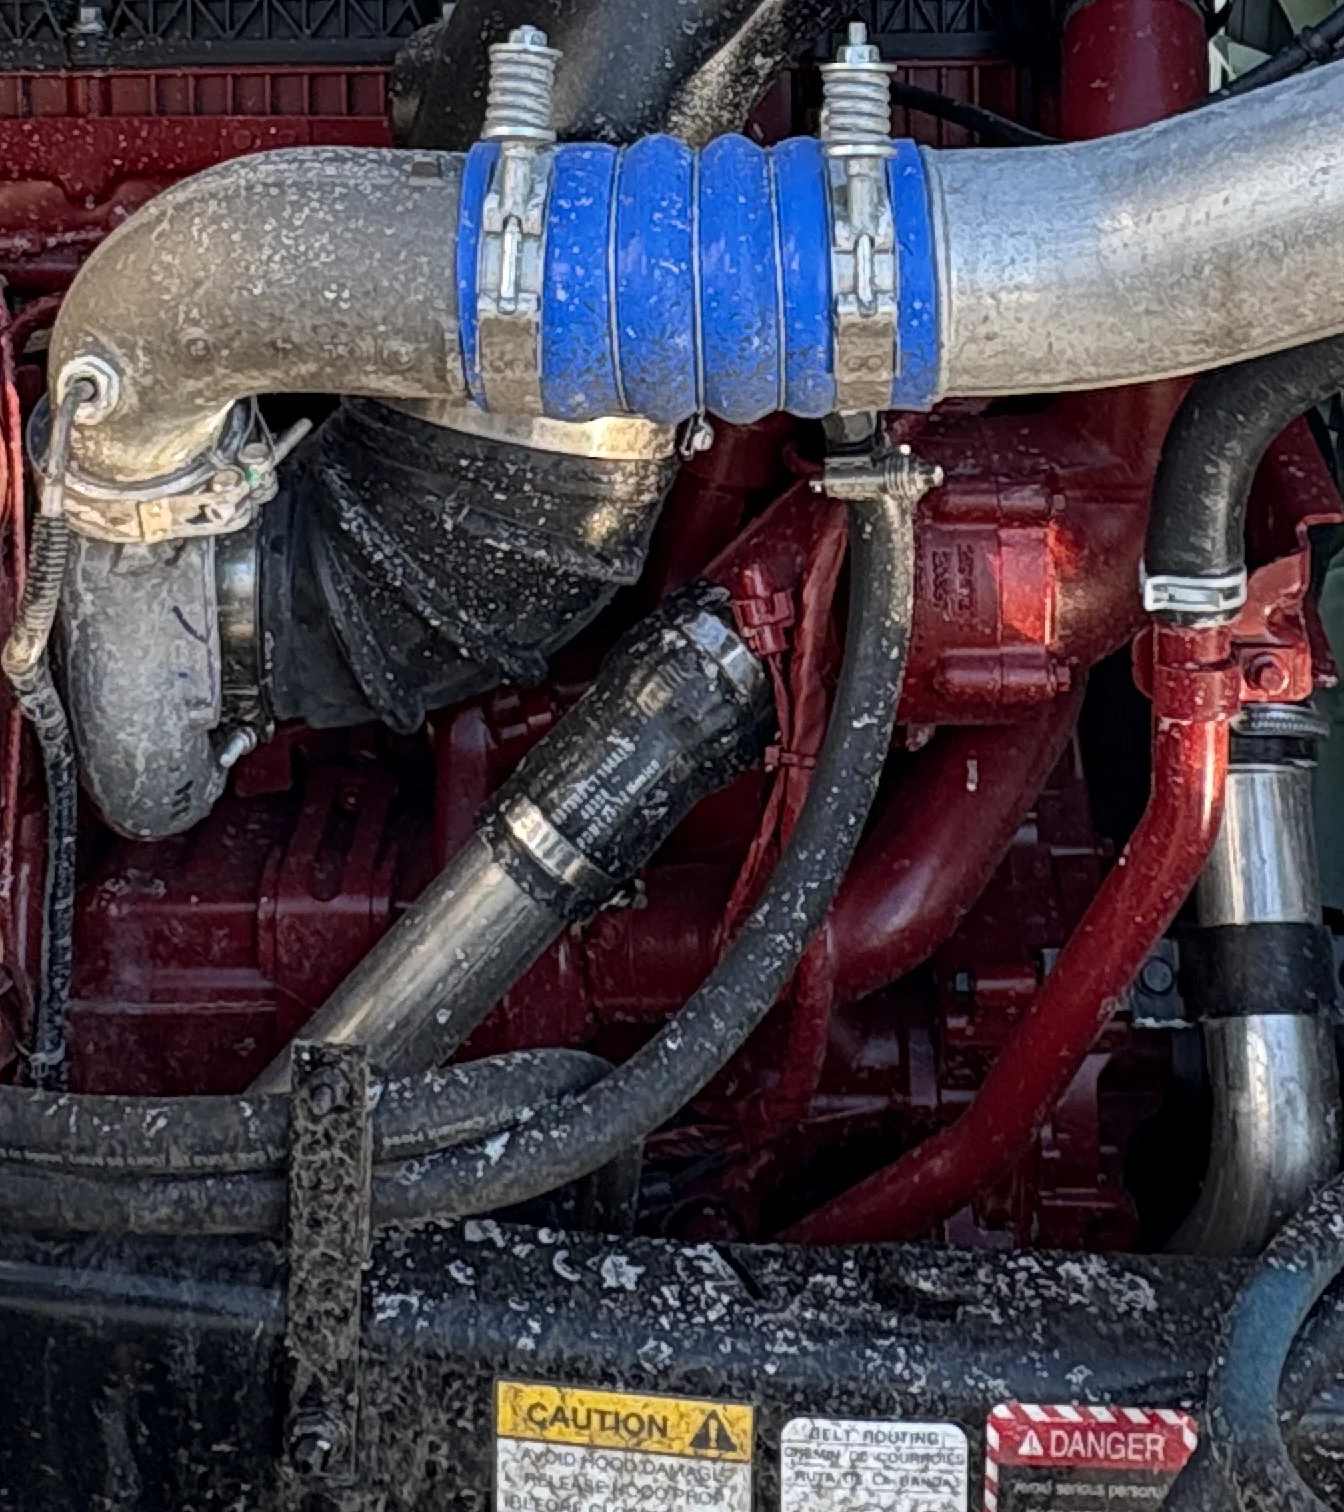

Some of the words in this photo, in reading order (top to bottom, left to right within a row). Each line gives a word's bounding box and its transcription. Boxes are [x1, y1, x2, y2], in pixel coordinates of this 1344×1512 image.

[525, 1401, 669, 1439] CAUTION
[862, 1429, 940, 1446] ROUTING
[1049, 1429, 1168, 1462] DANGER
[520, 1447, 577, 1467] AVOID
[579, 1452, 638, 1474] HOOD
[640, 1459, 737, 1484] DAMAGE
[524, 1471, 608, 1495] RELEASE
[612, 1482, 669, 1503] HOOD
